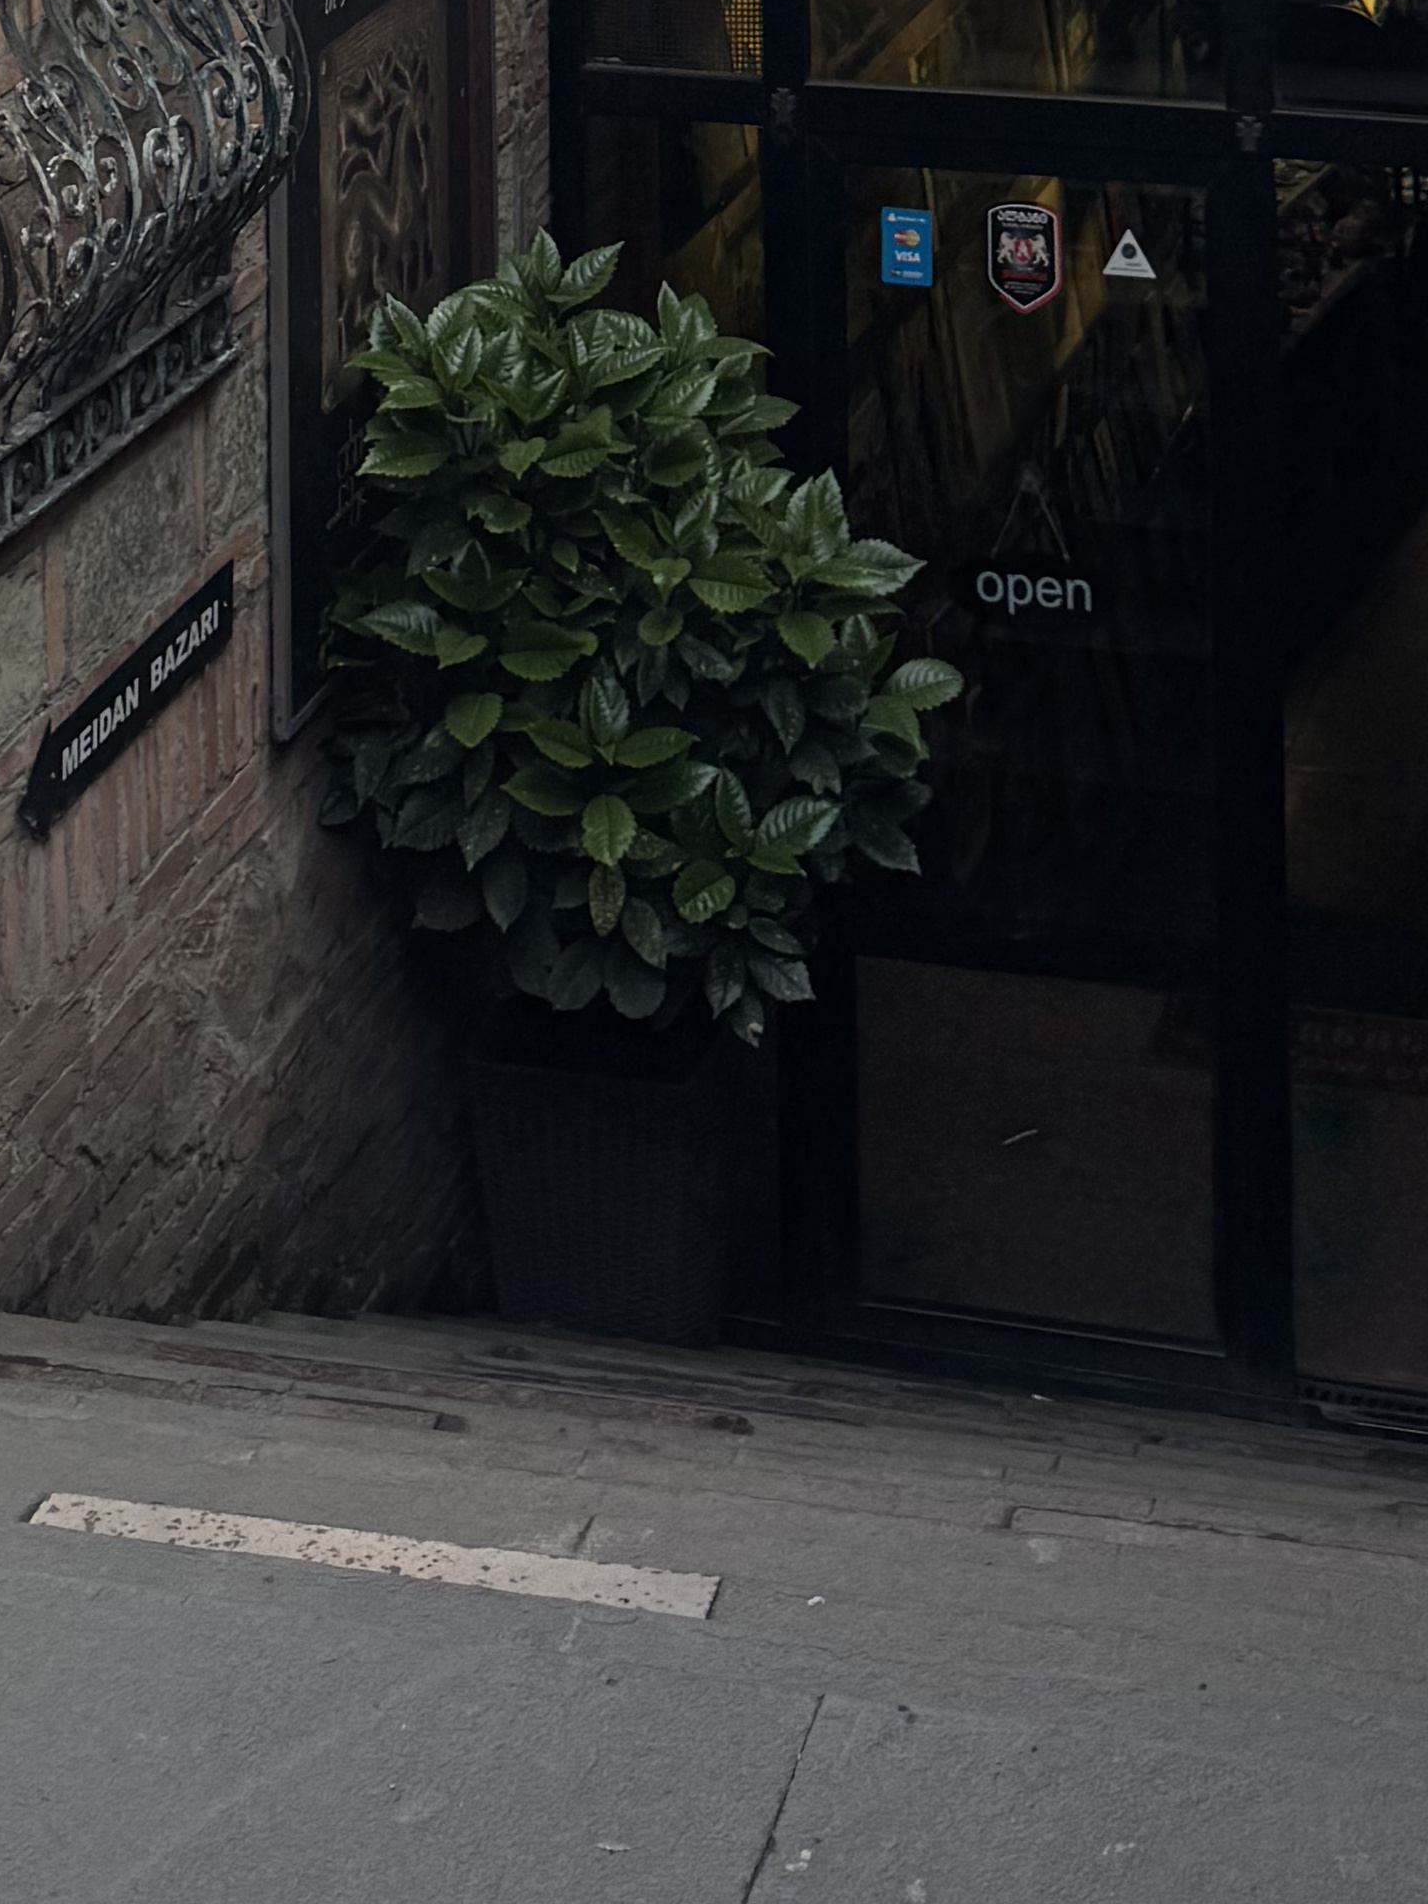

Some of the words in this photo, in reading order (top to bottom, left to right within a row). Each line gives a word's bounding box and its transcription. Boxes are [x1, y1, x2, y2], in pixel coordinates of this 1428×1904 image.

[894, 250, 921, 263] VISA
[976, 568, 1093, 615] open
[61, 677, 140, 781] MEIDAN
[150, 600, 220, 692] BAZARI
